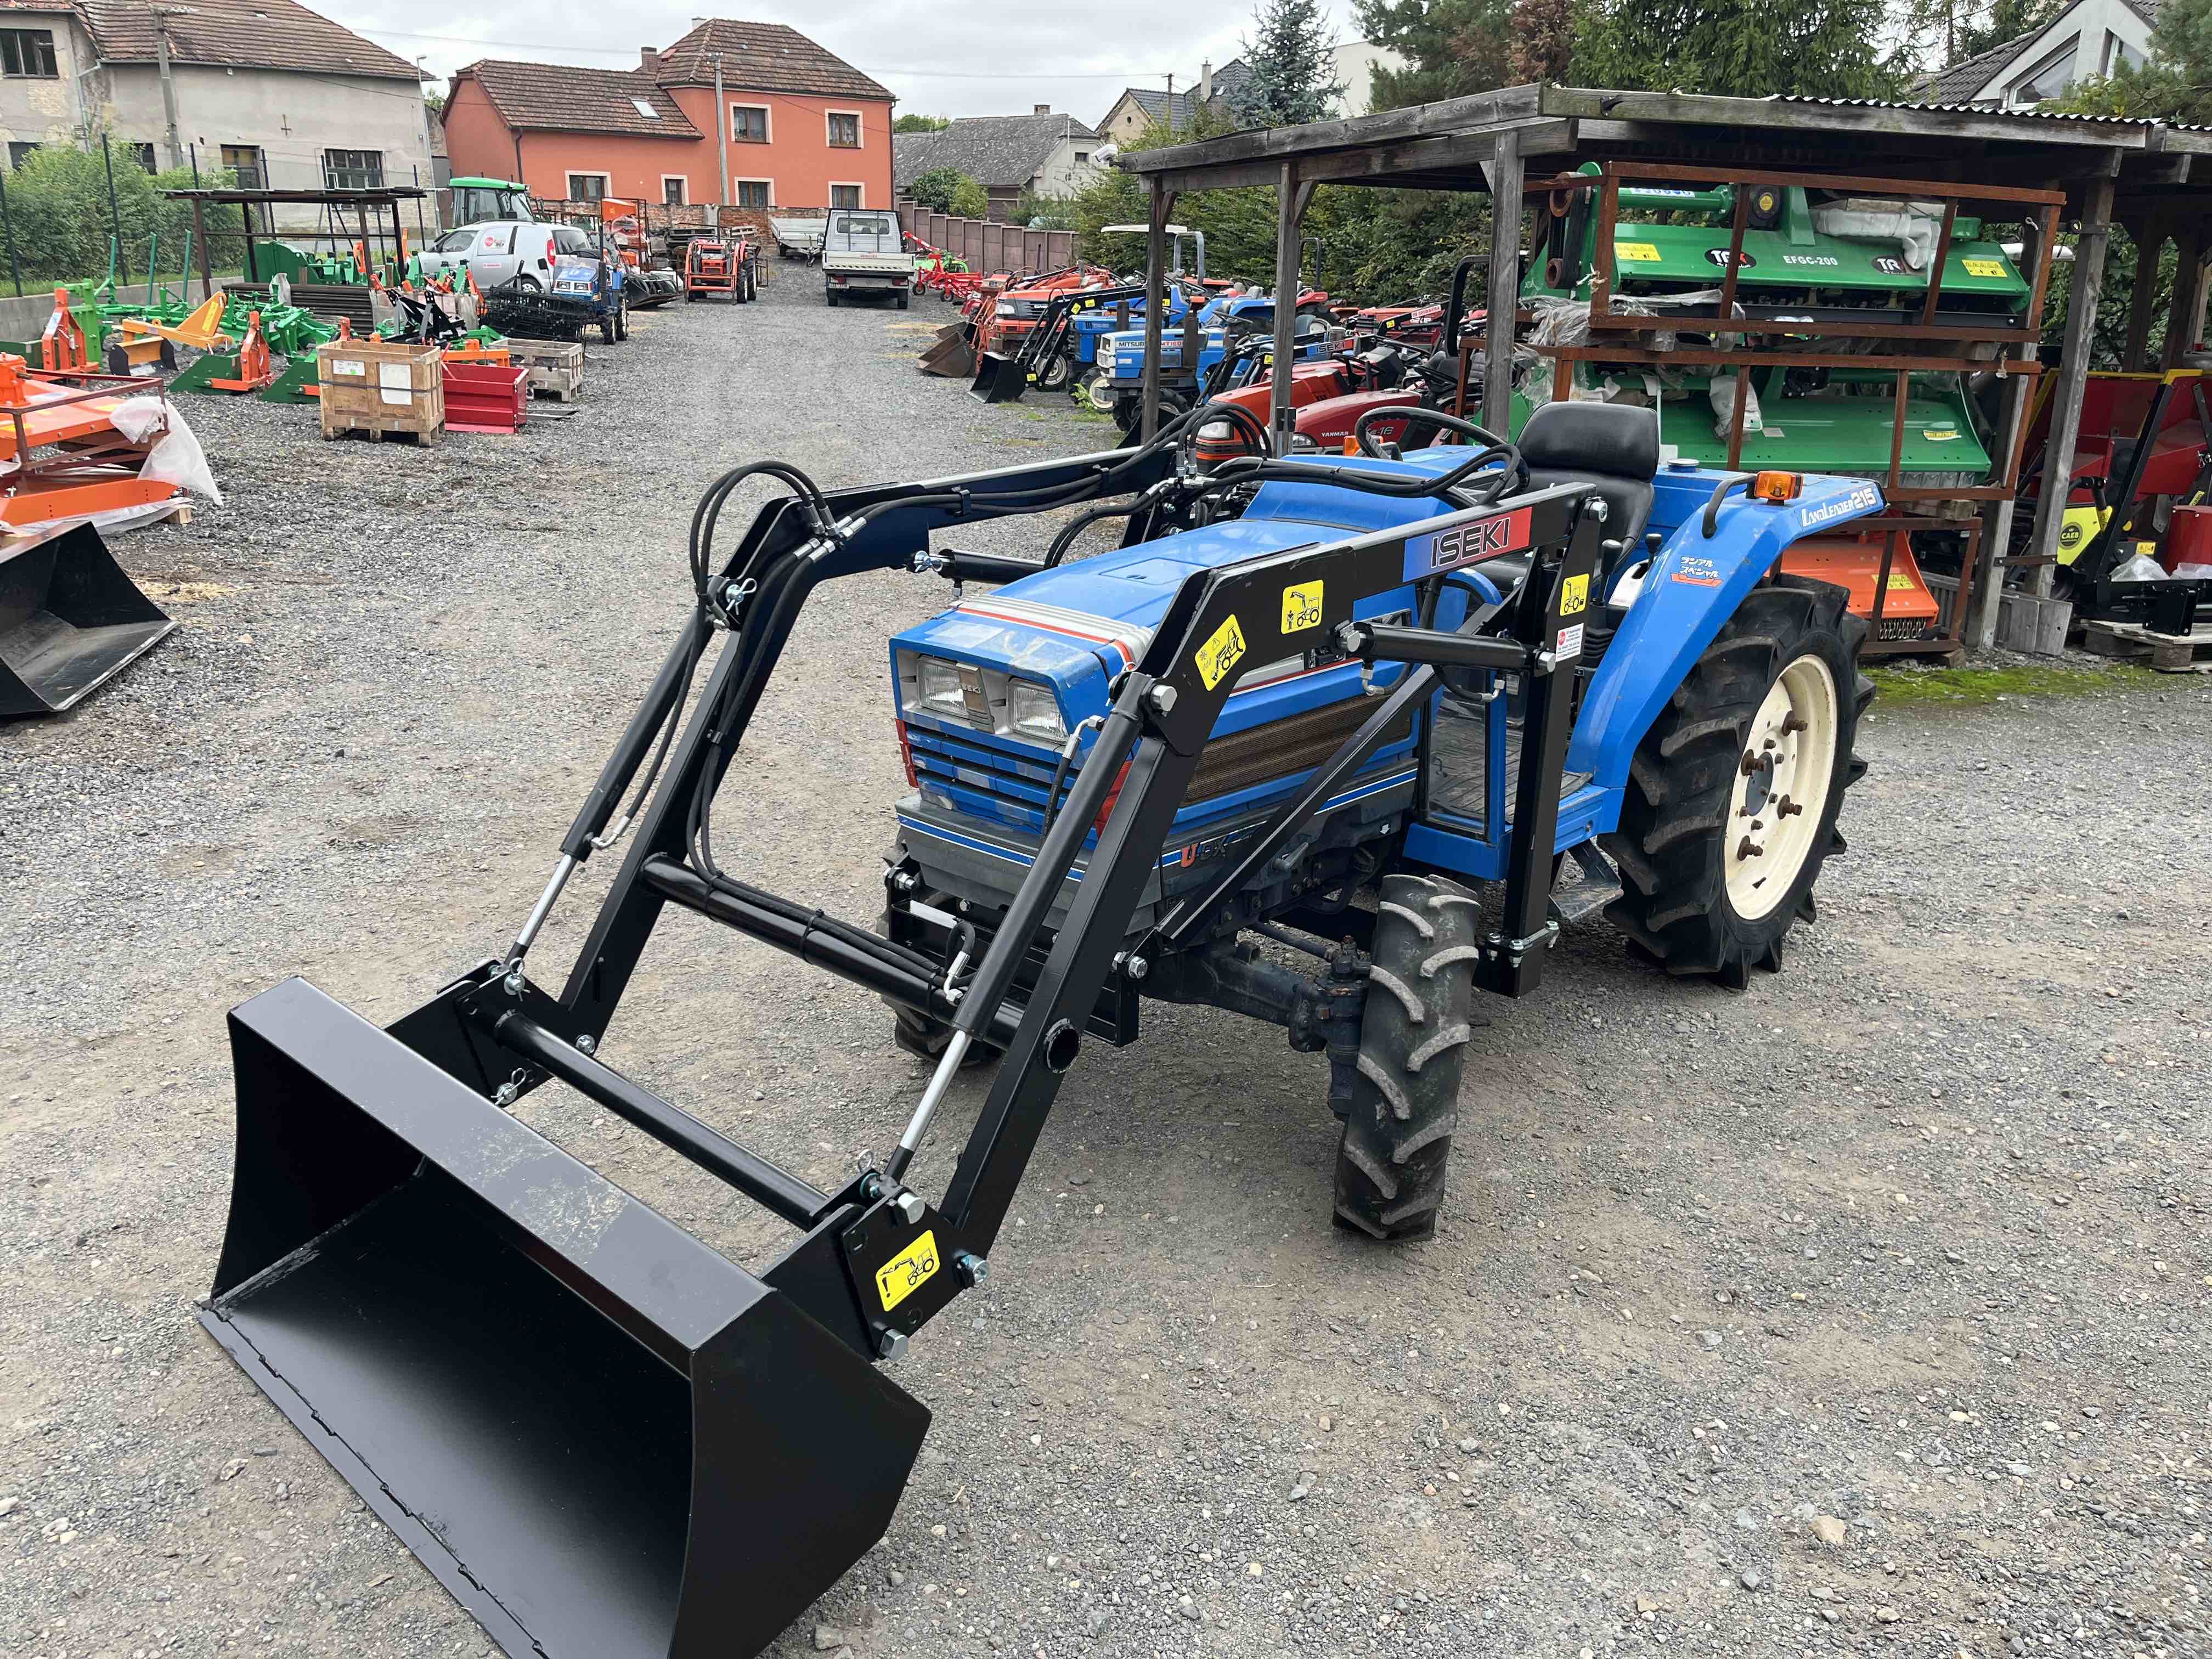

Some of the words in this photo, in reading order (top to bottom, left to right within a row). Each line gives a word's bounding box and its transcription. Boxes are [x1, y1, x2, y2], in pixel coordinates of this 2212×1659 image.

[1783, 255, 1838, 266] EFGC-200
[1316, 341, 1345, 353] ISEKI
[1850, 487, 1877, 510] 215
[1430, 517, 1510, 569] ISEKI
